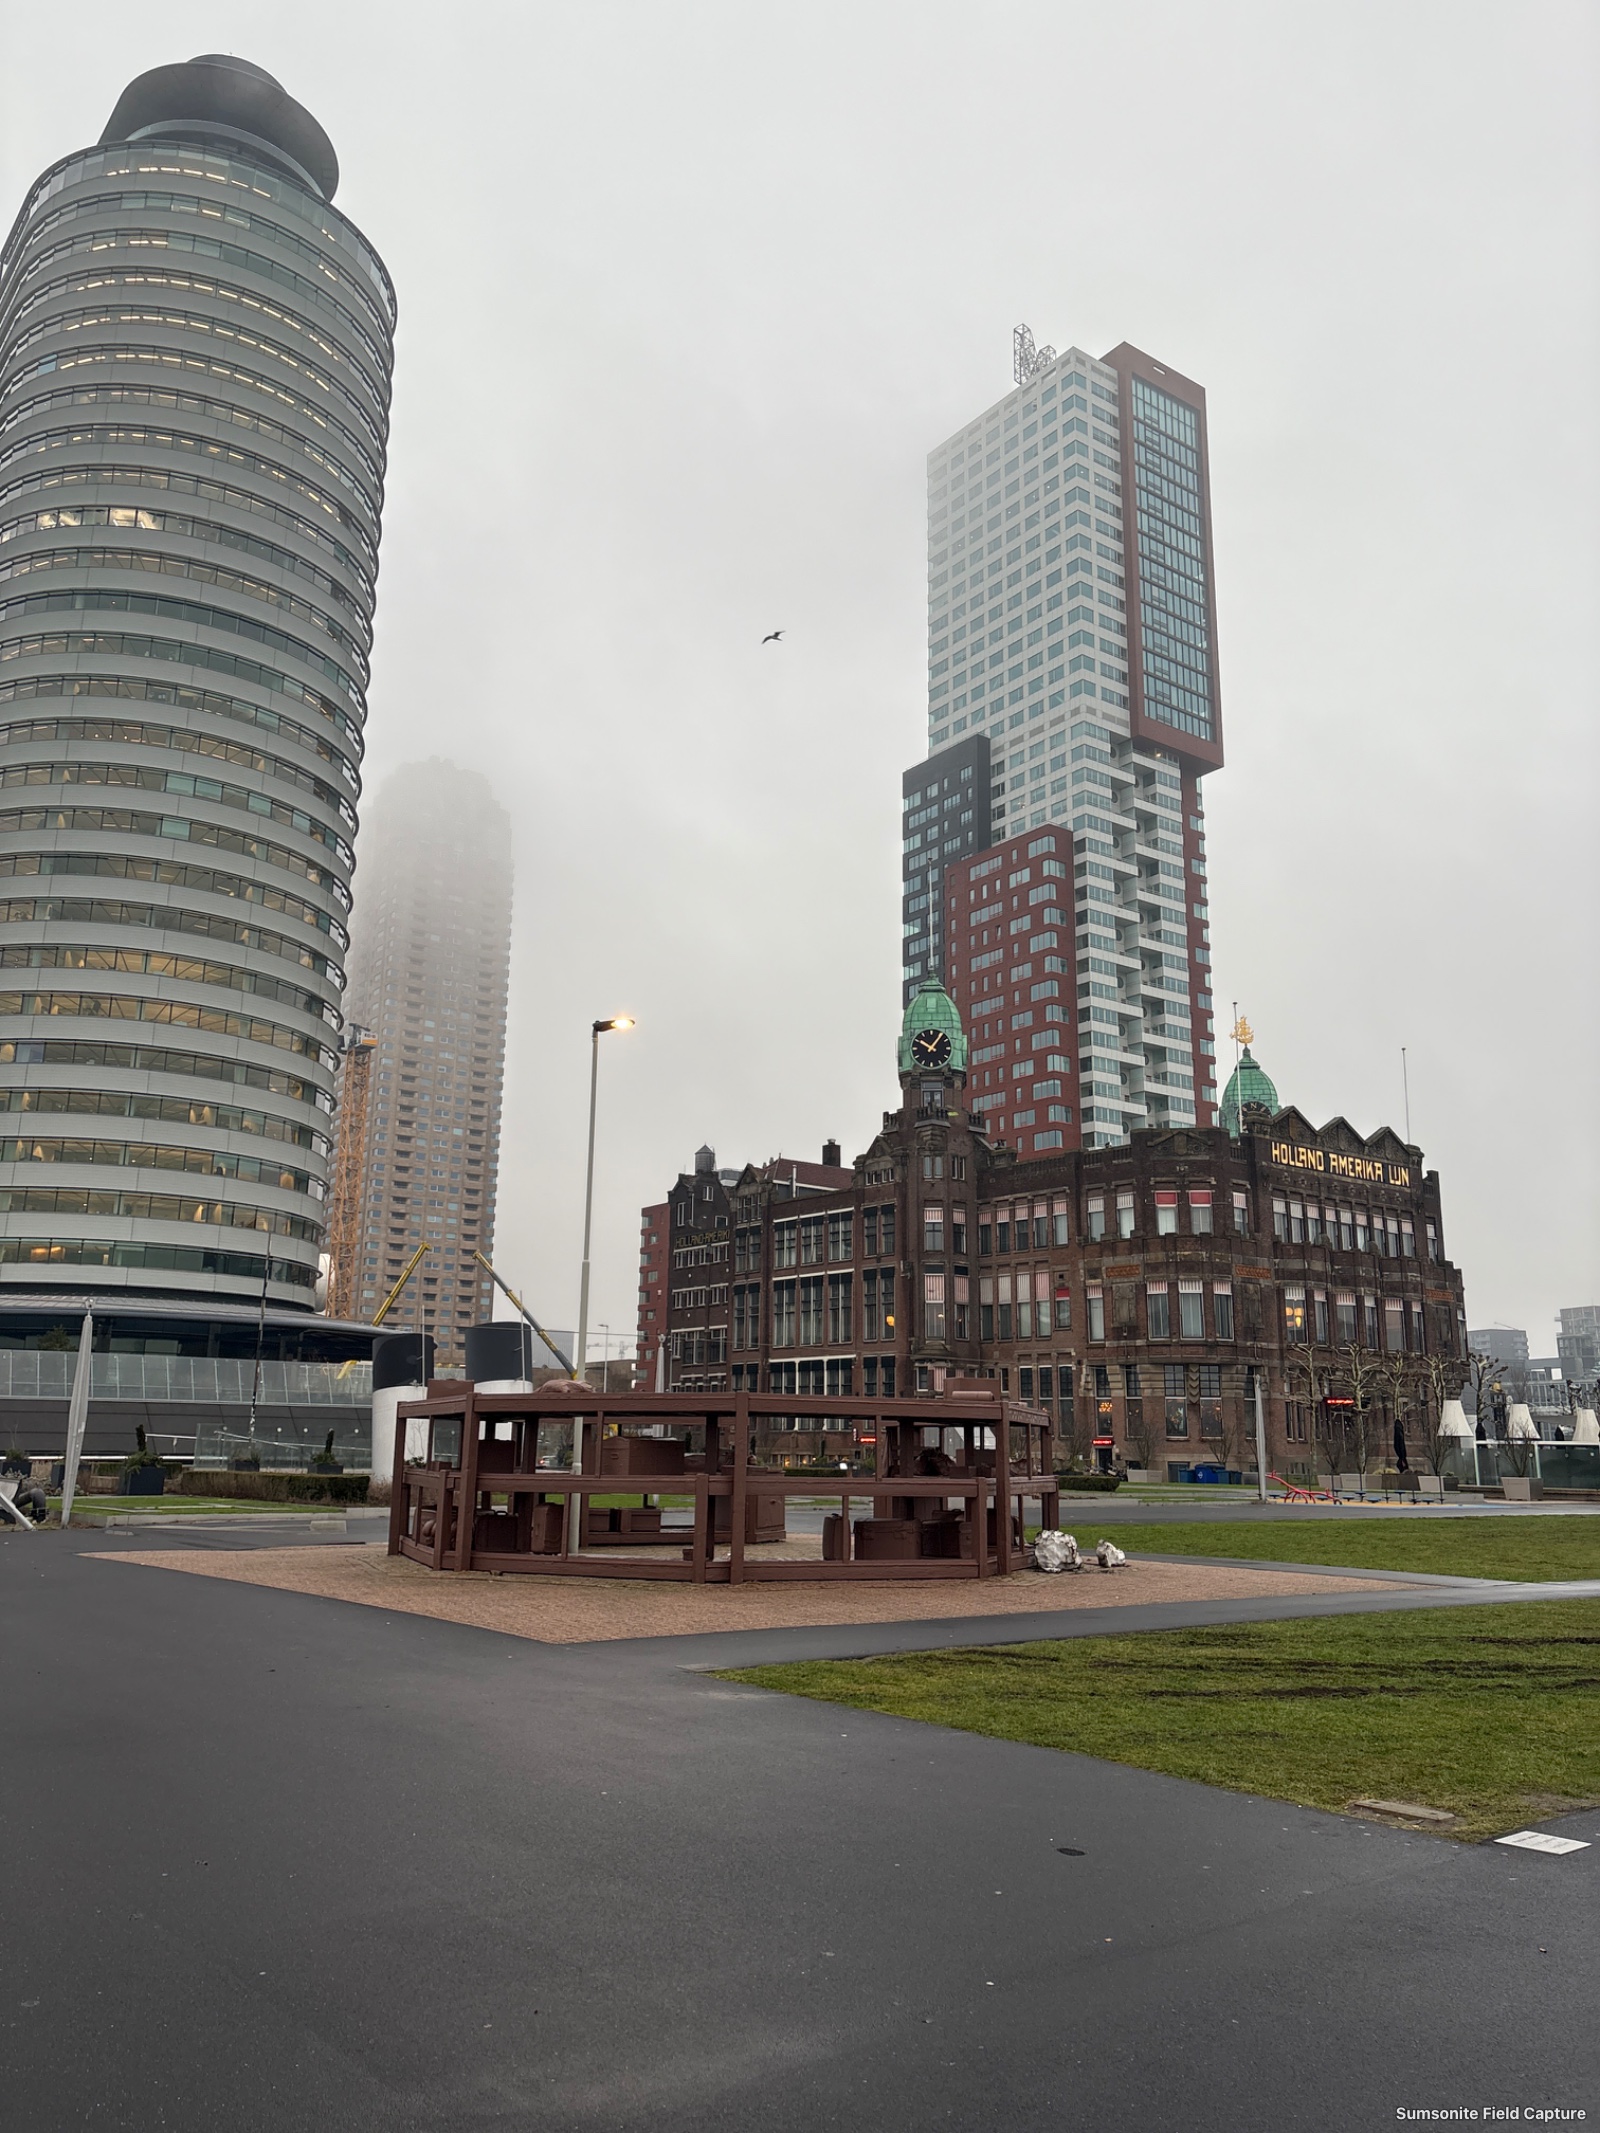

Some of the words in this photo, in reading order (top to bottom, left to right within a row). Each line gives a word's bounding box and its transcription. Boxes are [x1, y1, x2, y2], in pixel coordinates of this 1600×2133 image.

[1272, 1142, 1324, 1170] HOLLAND
[1329, 1153, 1383, 1182] AMERIKA
[1389, 1165, 1409, 1187] LIJN
